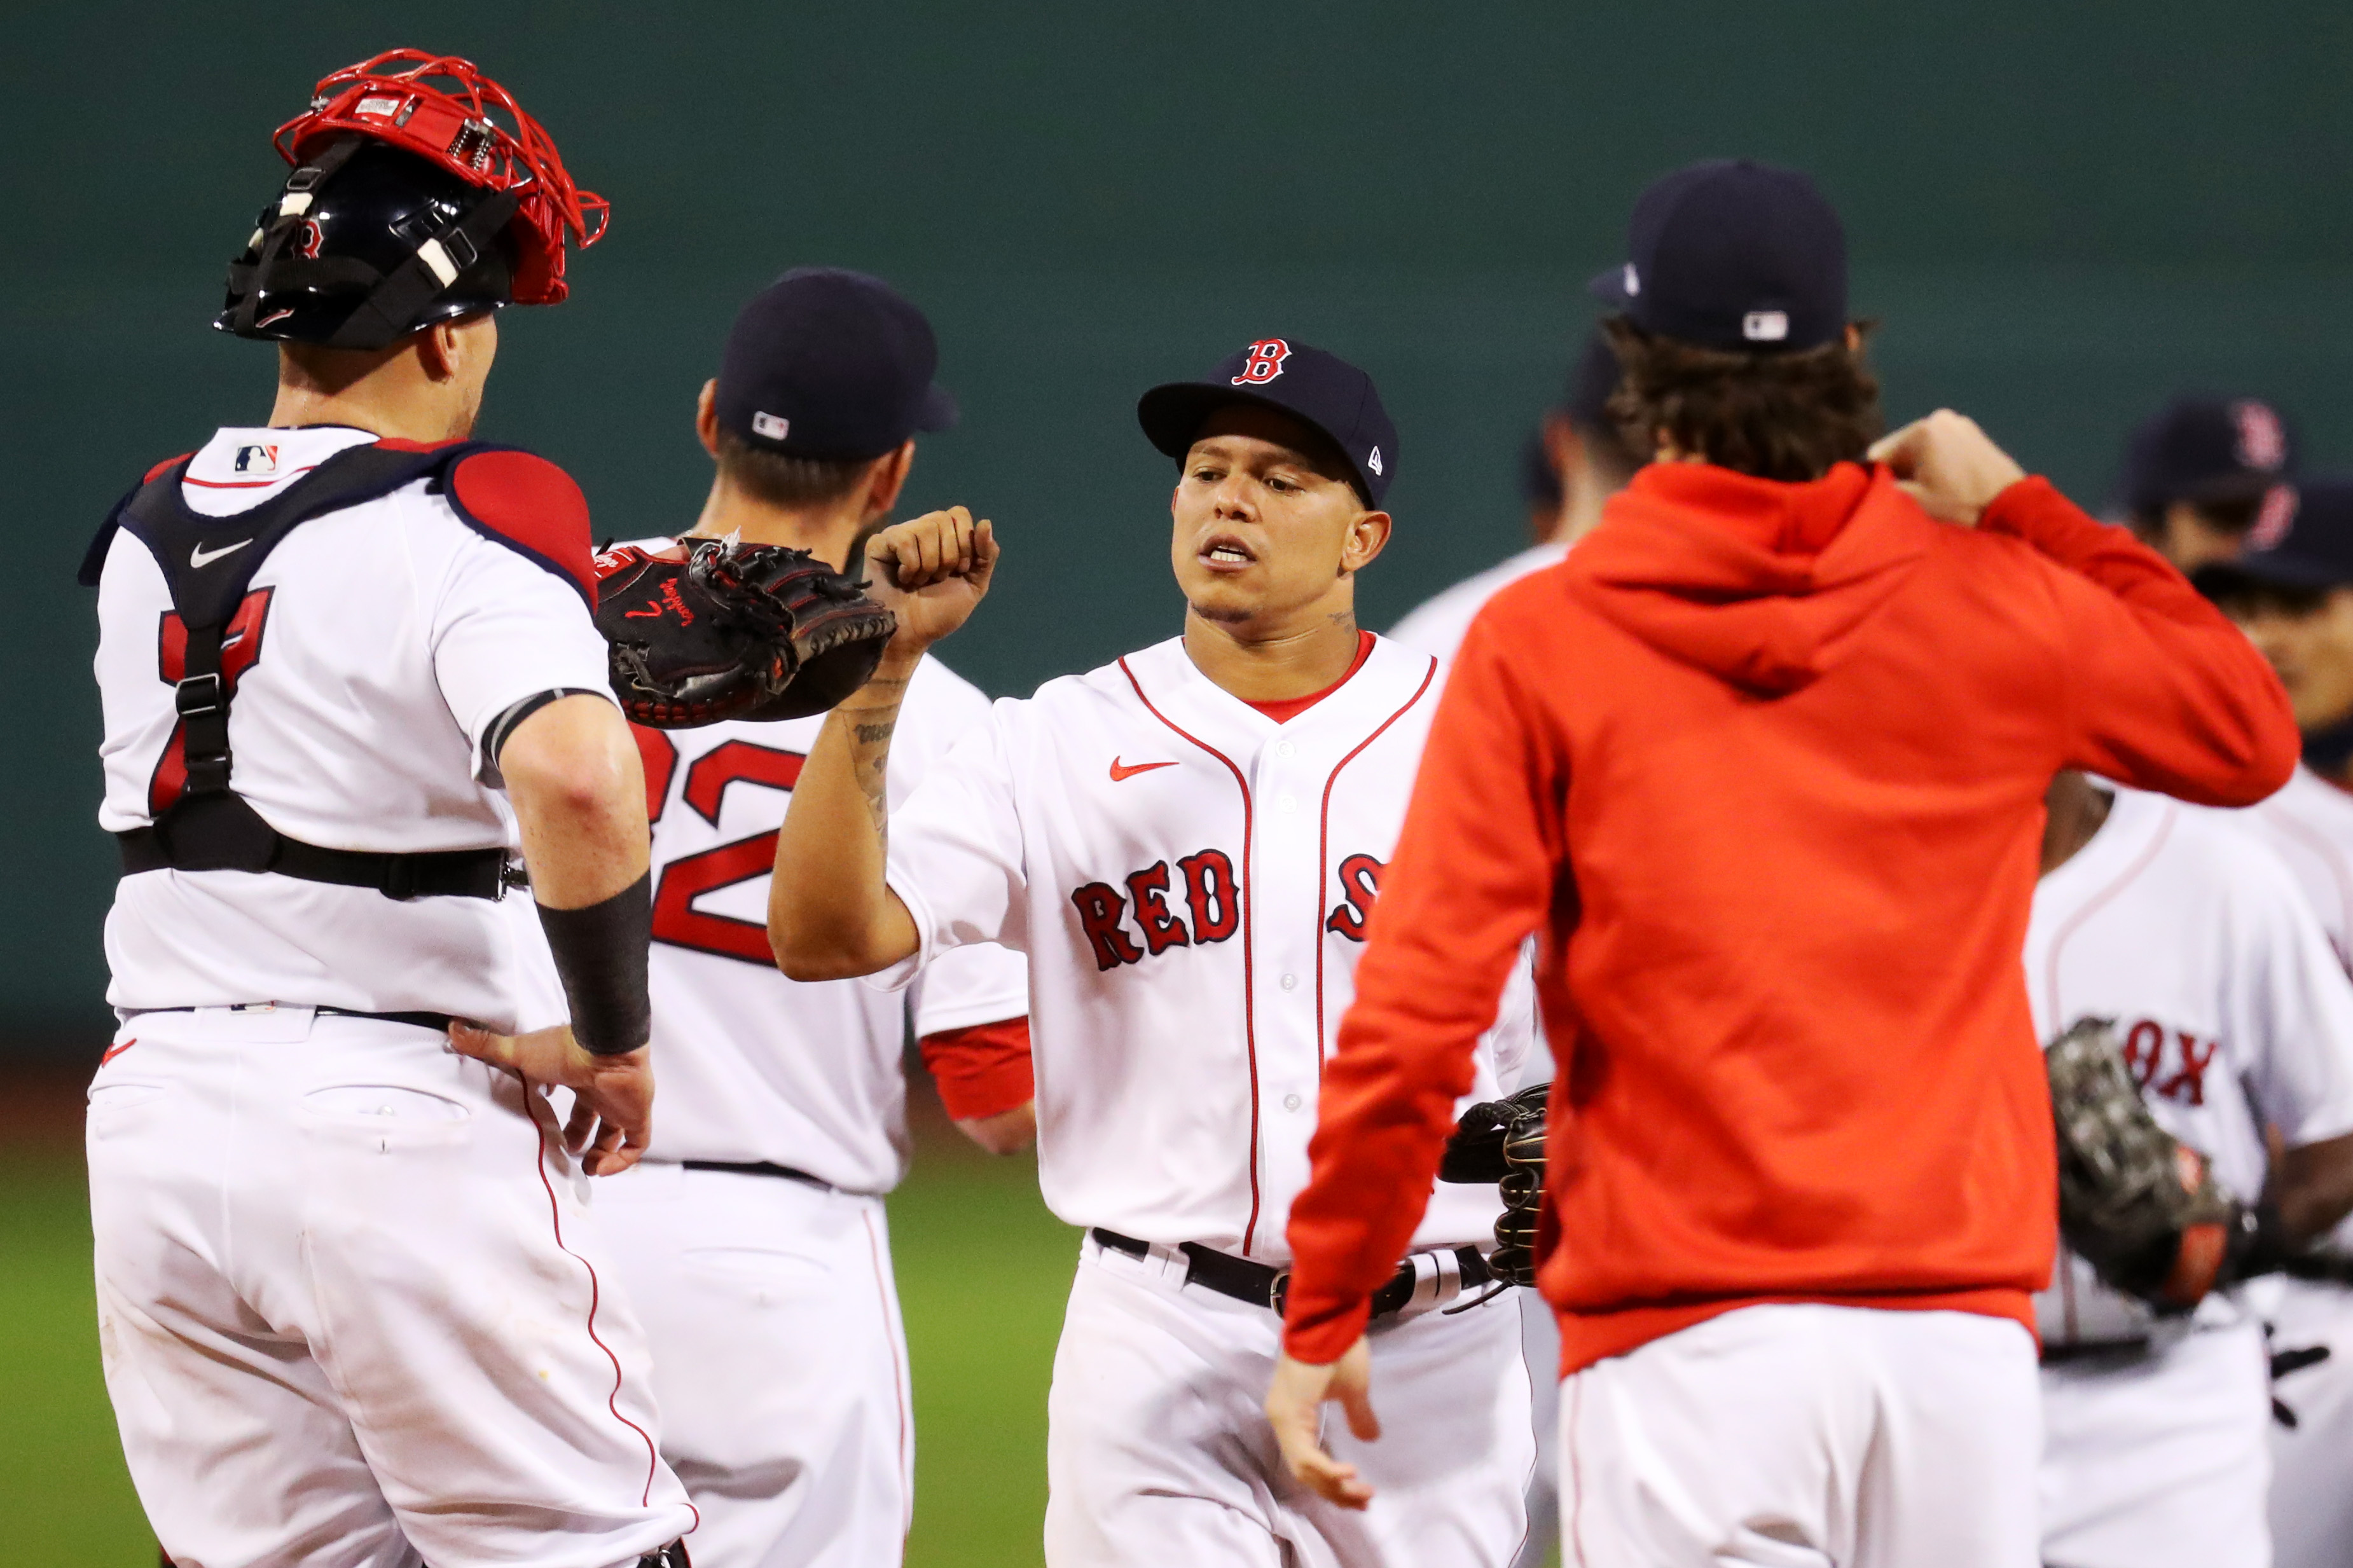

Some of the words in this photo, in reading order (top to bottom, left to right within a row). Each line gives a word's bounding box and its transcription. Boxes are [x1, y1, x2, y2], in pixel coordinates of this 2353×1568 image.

[1231, 338, 1292, 385] B
[624, 600, 663, 619] 7
[1071, 848, 1240, 972] RED
